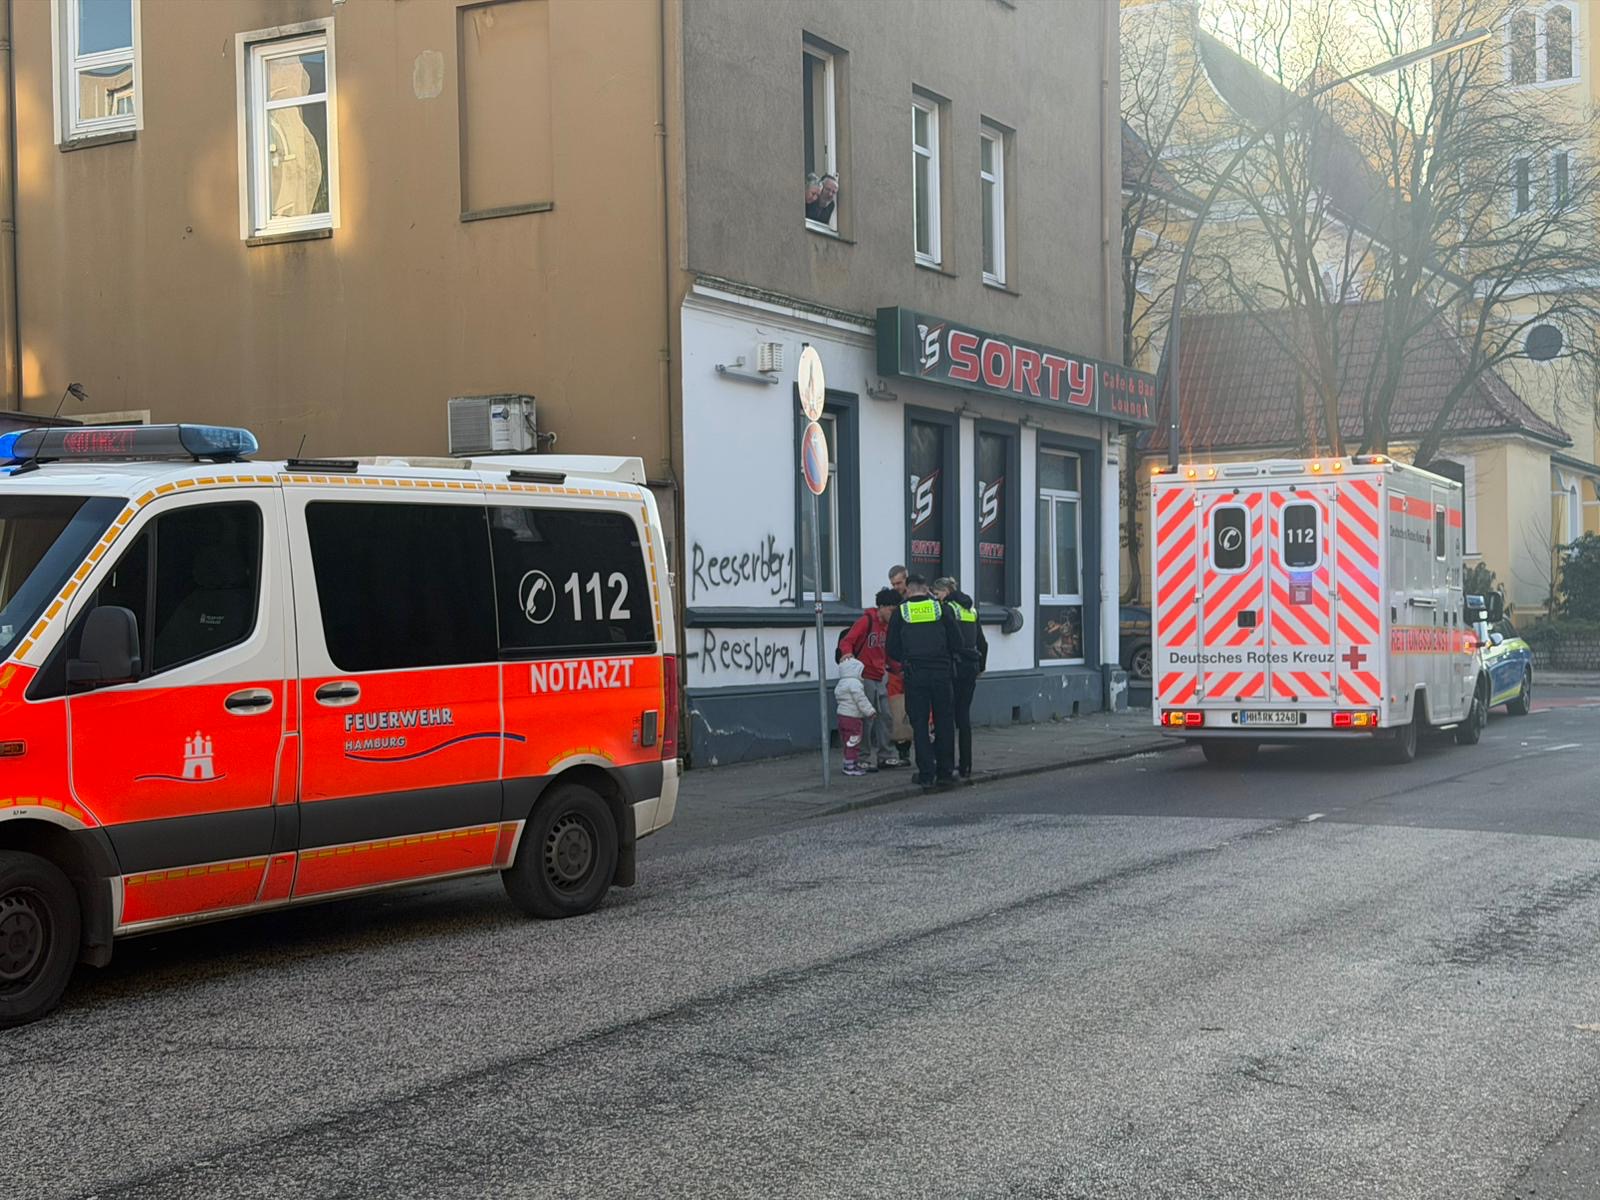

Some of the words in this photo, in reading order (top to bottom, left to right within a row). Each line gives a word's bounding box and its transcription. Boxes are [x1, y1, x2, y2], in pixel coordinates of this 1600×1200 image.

[948, 329, 1095, 407] SORTY
[1138, 379, 1155, 397] Bar
[1287, 528, 1315, 544] 112
[564, 571, 631, 621] 112
[910, 606, 934, 615] POLIZEI
[1169, 652, 1242, 664] Deutsches
[1247, 652, 1288, 664] Rotes
[1293, 651, 1335, 664] Kreuz
[530, 659, 634, 694] NOTARZT
[344, 707, 454, 732] FEUERWEHR
[344, 736, 407, 752] HAMBURG
